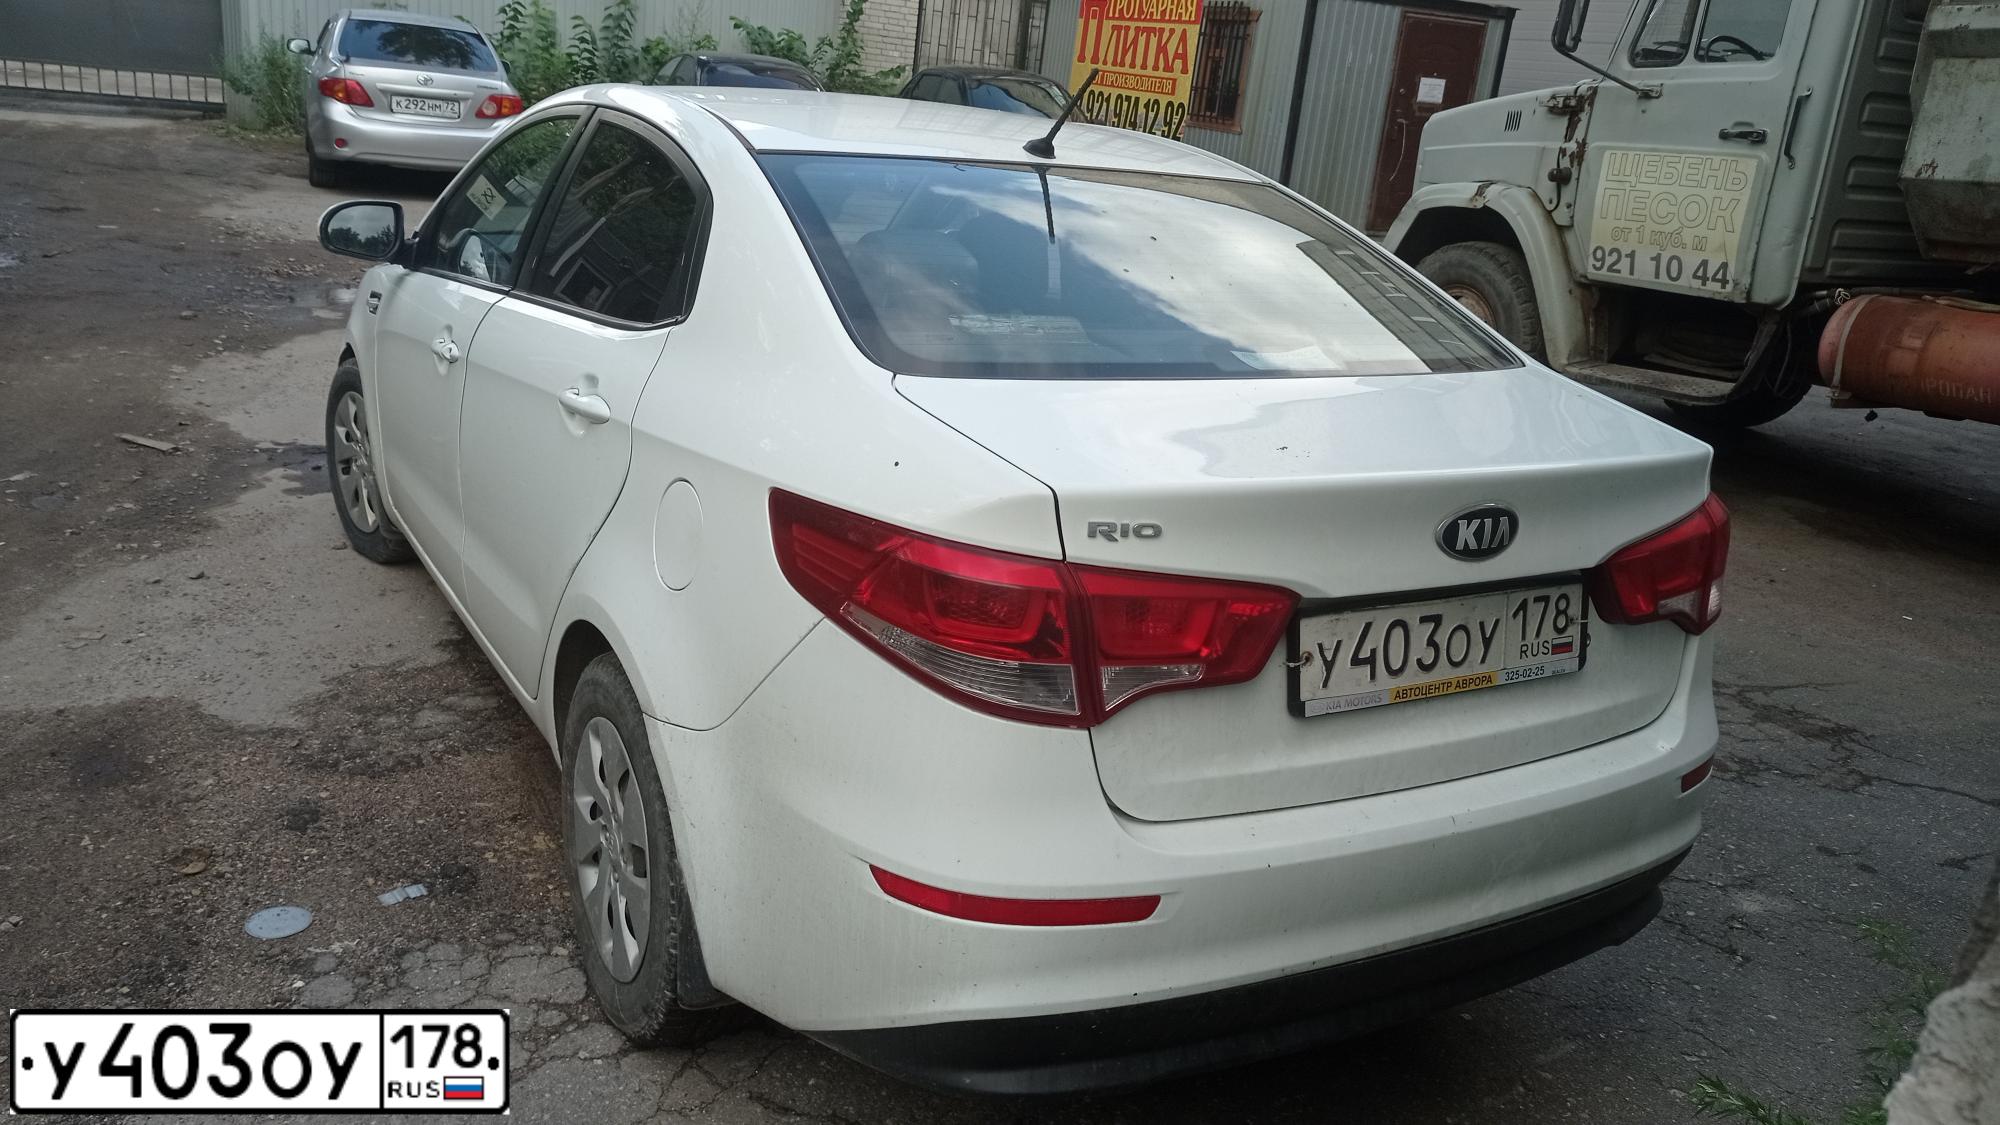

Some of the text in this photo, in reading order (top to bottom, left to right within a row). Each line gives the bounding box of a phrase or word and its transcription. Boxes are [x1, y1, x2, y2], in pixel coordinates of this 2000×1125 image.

[1103, 74, 1172, 93] ПРОИЗВОДИТЕЛЯ
[1605, 152, 1748, 192] ЩЕБЕНЬ
[1600, 188, 1741, 233] ПЕСОК
[1611, 225, 1632, 243] от
[1636, 225, 1646, 244] 1
[1591, 245, 1730, 290] 921 10 44
[1087, 520, 1163, 543] RIO
[1455, 516, 1510, 551] KIA
[1316, 592, 1571, 690] У403ОУ 178
[1519, 640, 1550, 660] RUS
[1393, 672, 1494, 701] АВТОЦЕНТР АВРОРА
[1504, 665, 1545, 682] 325-02-25
